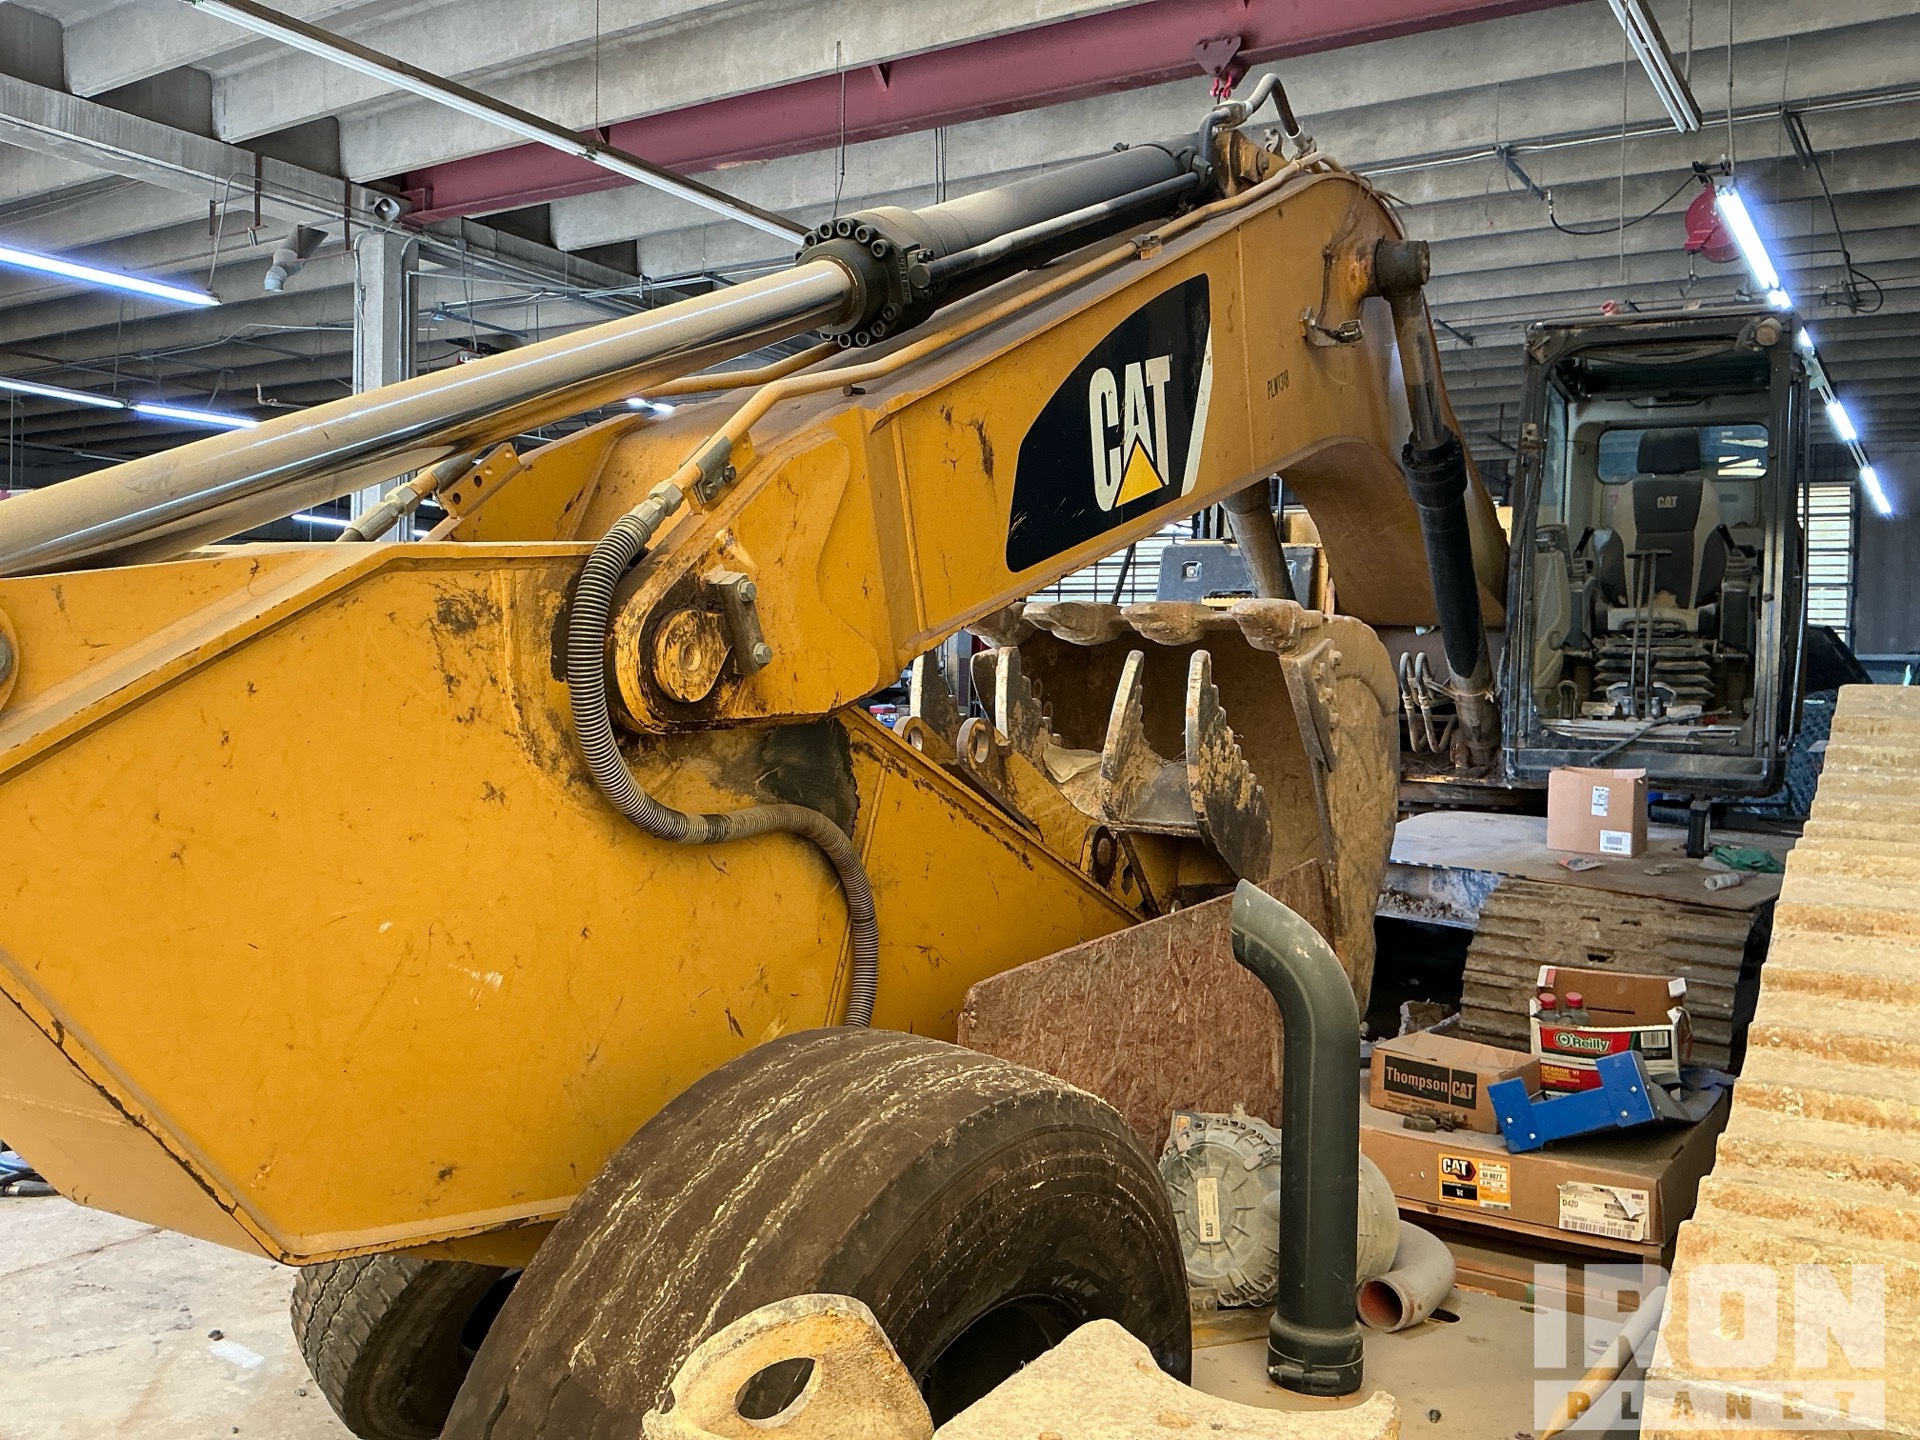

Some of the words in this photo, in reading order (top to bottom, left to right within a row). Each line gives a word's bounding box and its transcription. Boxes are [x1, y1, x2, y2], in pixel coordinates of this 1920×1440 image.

[1089, 355, 1170, 512] CAT
[1657, 495, 1678, 509] CAT
[1556, 1032, 1610, 1053] O'Reilly
[1386, 1066, 1449, 1092] Thompson
[1452, 1081, 1475, 1099] CAT
[1442, 1158, 1468, 1176] CAT
[1205, 1221, 1214, 1237] CAT
